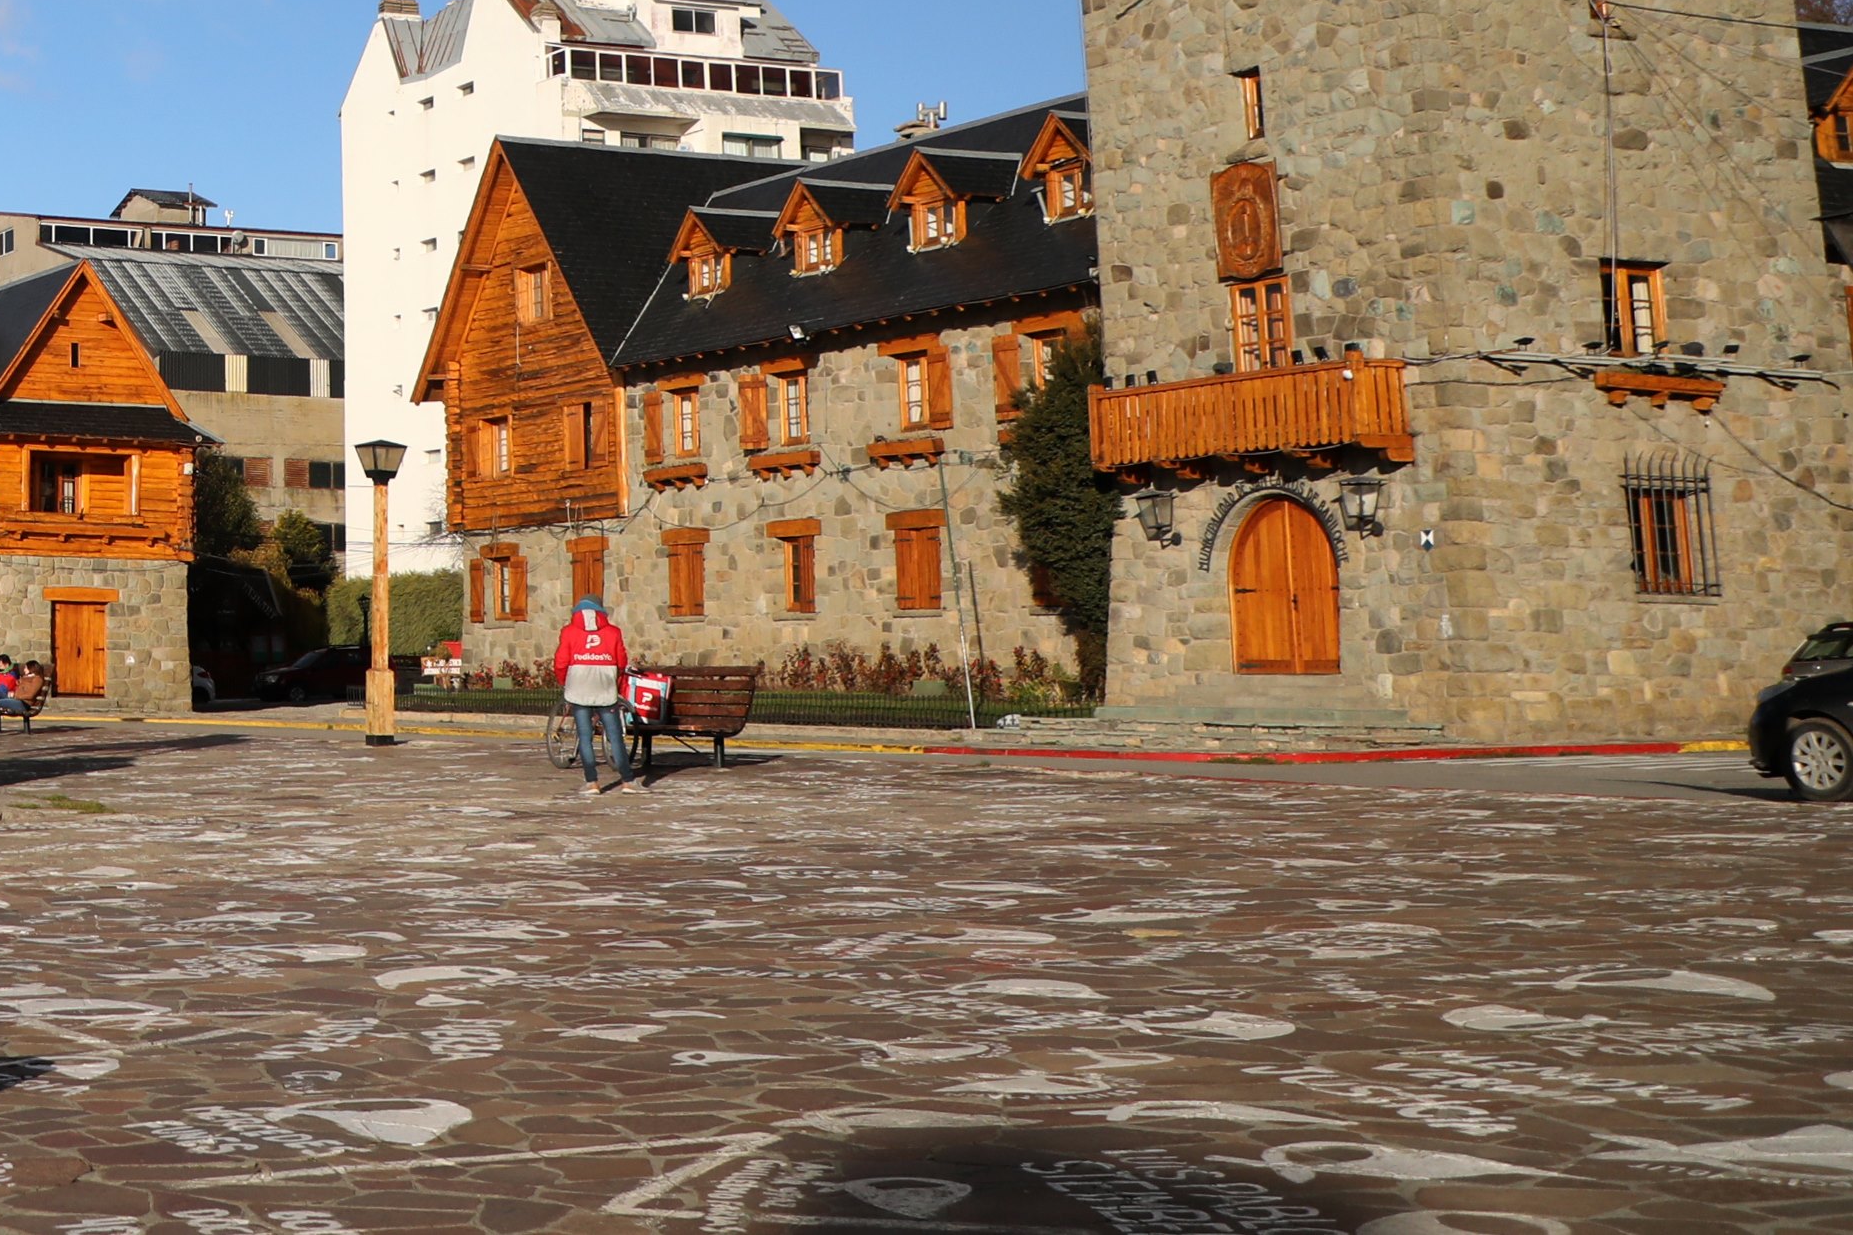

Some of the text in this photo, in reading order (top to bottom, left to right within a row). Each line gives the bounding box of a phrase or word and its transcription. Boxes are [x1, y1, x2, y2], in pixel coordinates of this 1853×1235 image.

[1317, 500, 1350, 568] BARILOCHE
[419, 1018, 517, 1063] FUERZA
[182, 1105, 372, 1158] MERCEDES
[1021, 1159, 1235, 1235] STEIMBE
